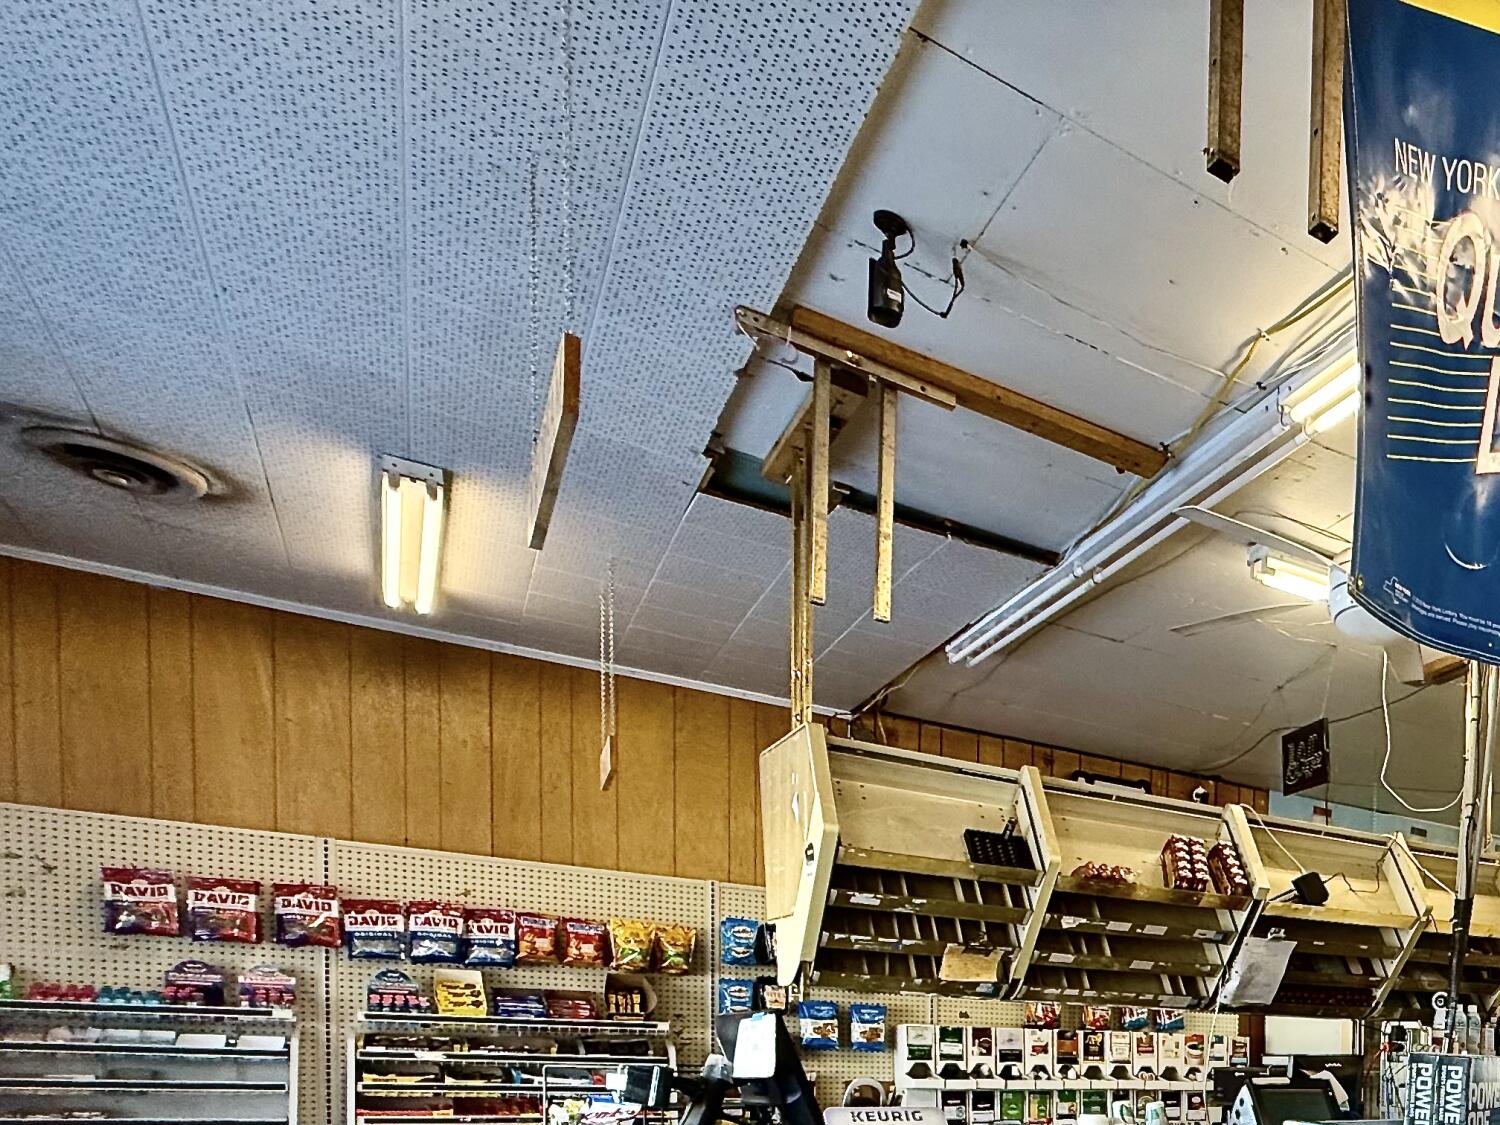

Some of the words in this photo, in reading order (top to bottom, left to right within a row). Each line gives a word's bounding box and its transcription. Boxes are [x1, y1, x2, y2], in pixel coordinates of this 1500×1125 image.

[1394, 138, 1436, 183] NEW
[1441, 156, 1500, 200] YORK
[111, 882, 169, 898] DAVID
[194, 890, 250, 906] DAVID
[281, 897, 333, 913] DAVID
[349, 915, 398, 927] DAVID
[850, 1110, 924, 1122] KEURIG
